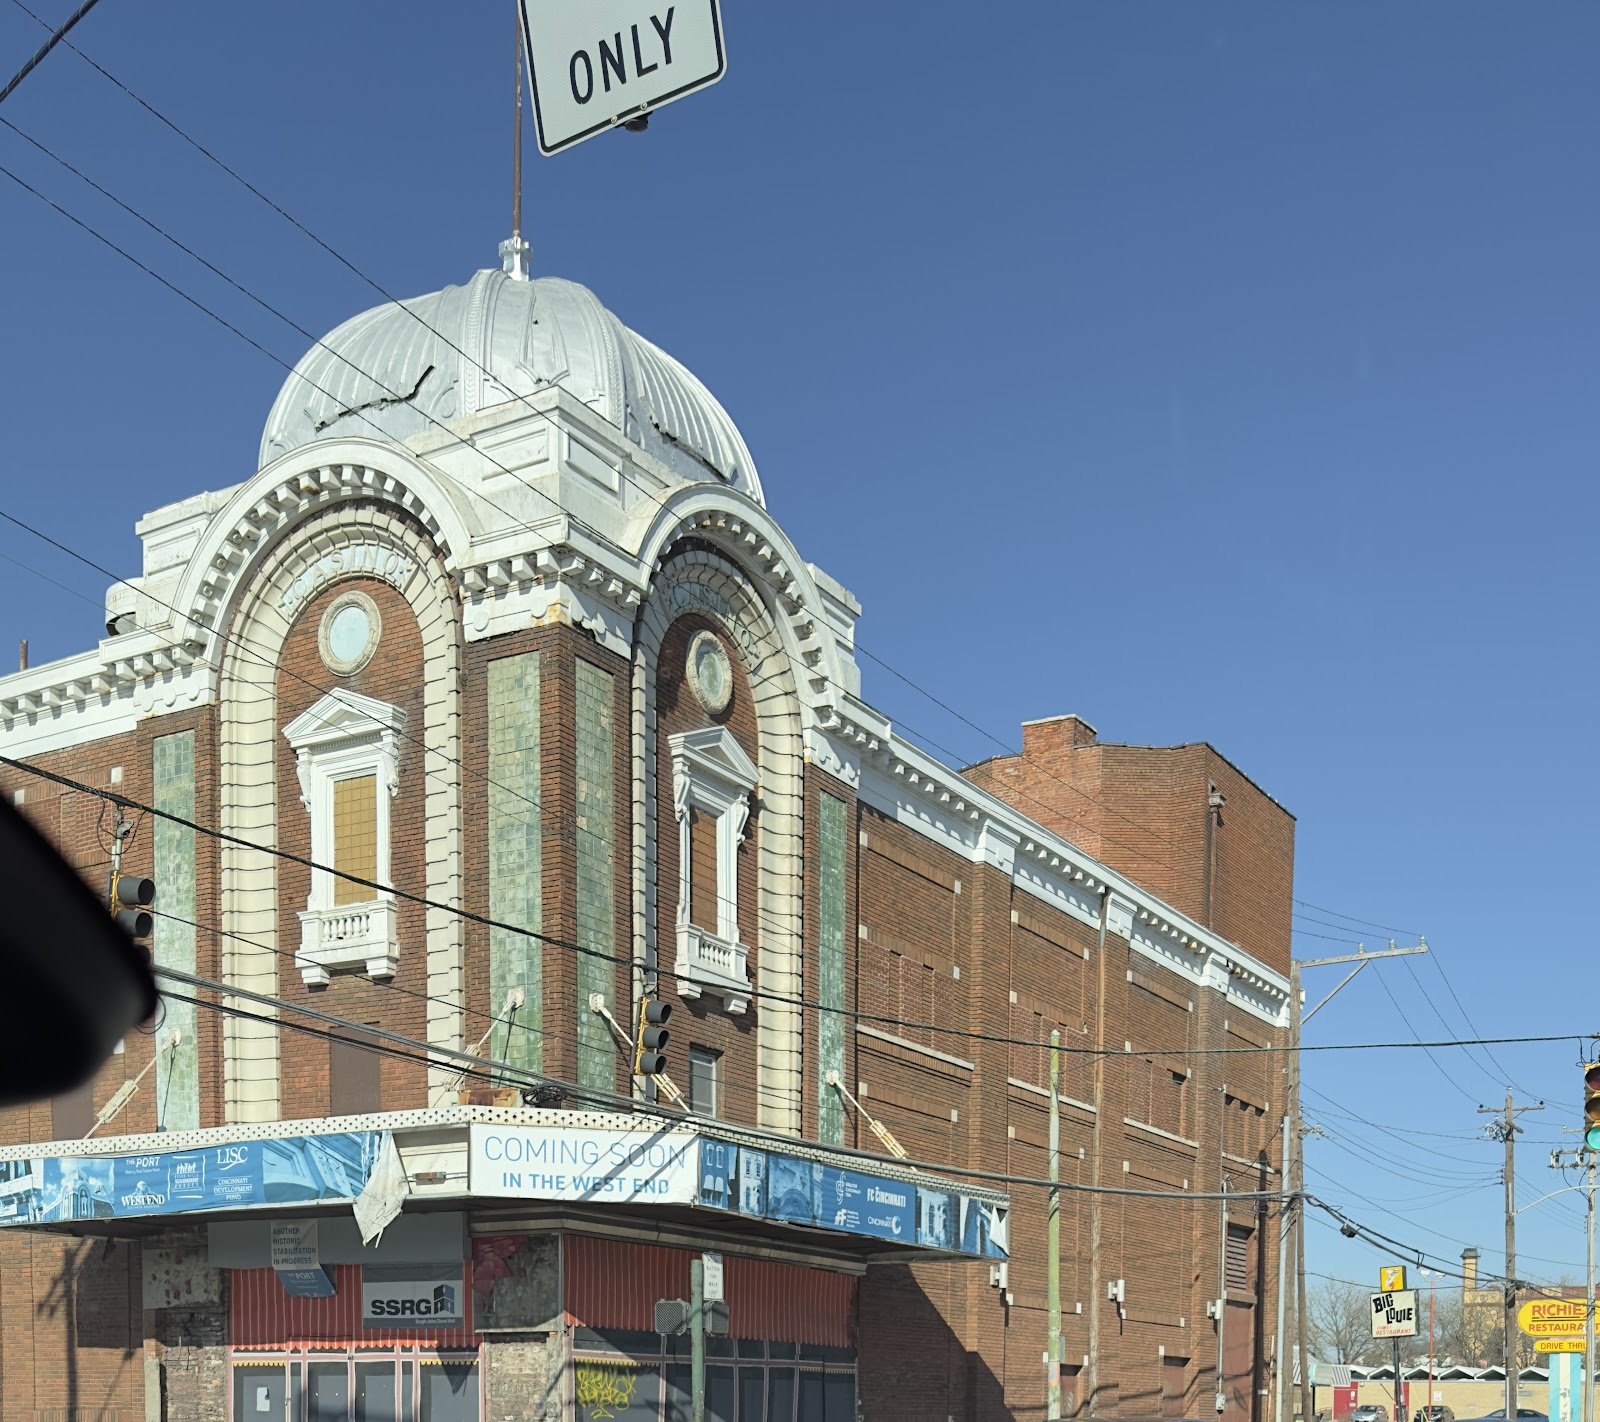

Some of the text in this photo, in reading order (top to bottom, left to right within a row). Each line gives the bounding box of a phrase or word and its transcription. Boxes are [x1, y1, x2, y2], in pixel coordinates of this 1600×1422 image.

[569, 6, 675, 105] ONLY
[292, 544, 399, 600] CASINO
[216, 1146, 249, 1164] LISC
[485, 1136, 685, 1169] COMING SOON
[135, 1157, 160, 1168] PORT
[218, 1178, 249, 1186] CINCINNATI
[503, 1172, 669, 1194] IN THE WEST END
[867, 1188, 875, 1202] FC
[273, 1227, 300, 1235] ANOTHER
[273, 1247, 316, 1255] STABILIZATION
[371, 1298, 432, 1316] SSRG
[1373, 1293, 1394, 1313] BIG
[1385, 1307, 1413, 1324] LOUIE
[1528, 1323, 1600, 1332] RESTAURAT
[1540, 1342, 1563, 1350] DRIVE
